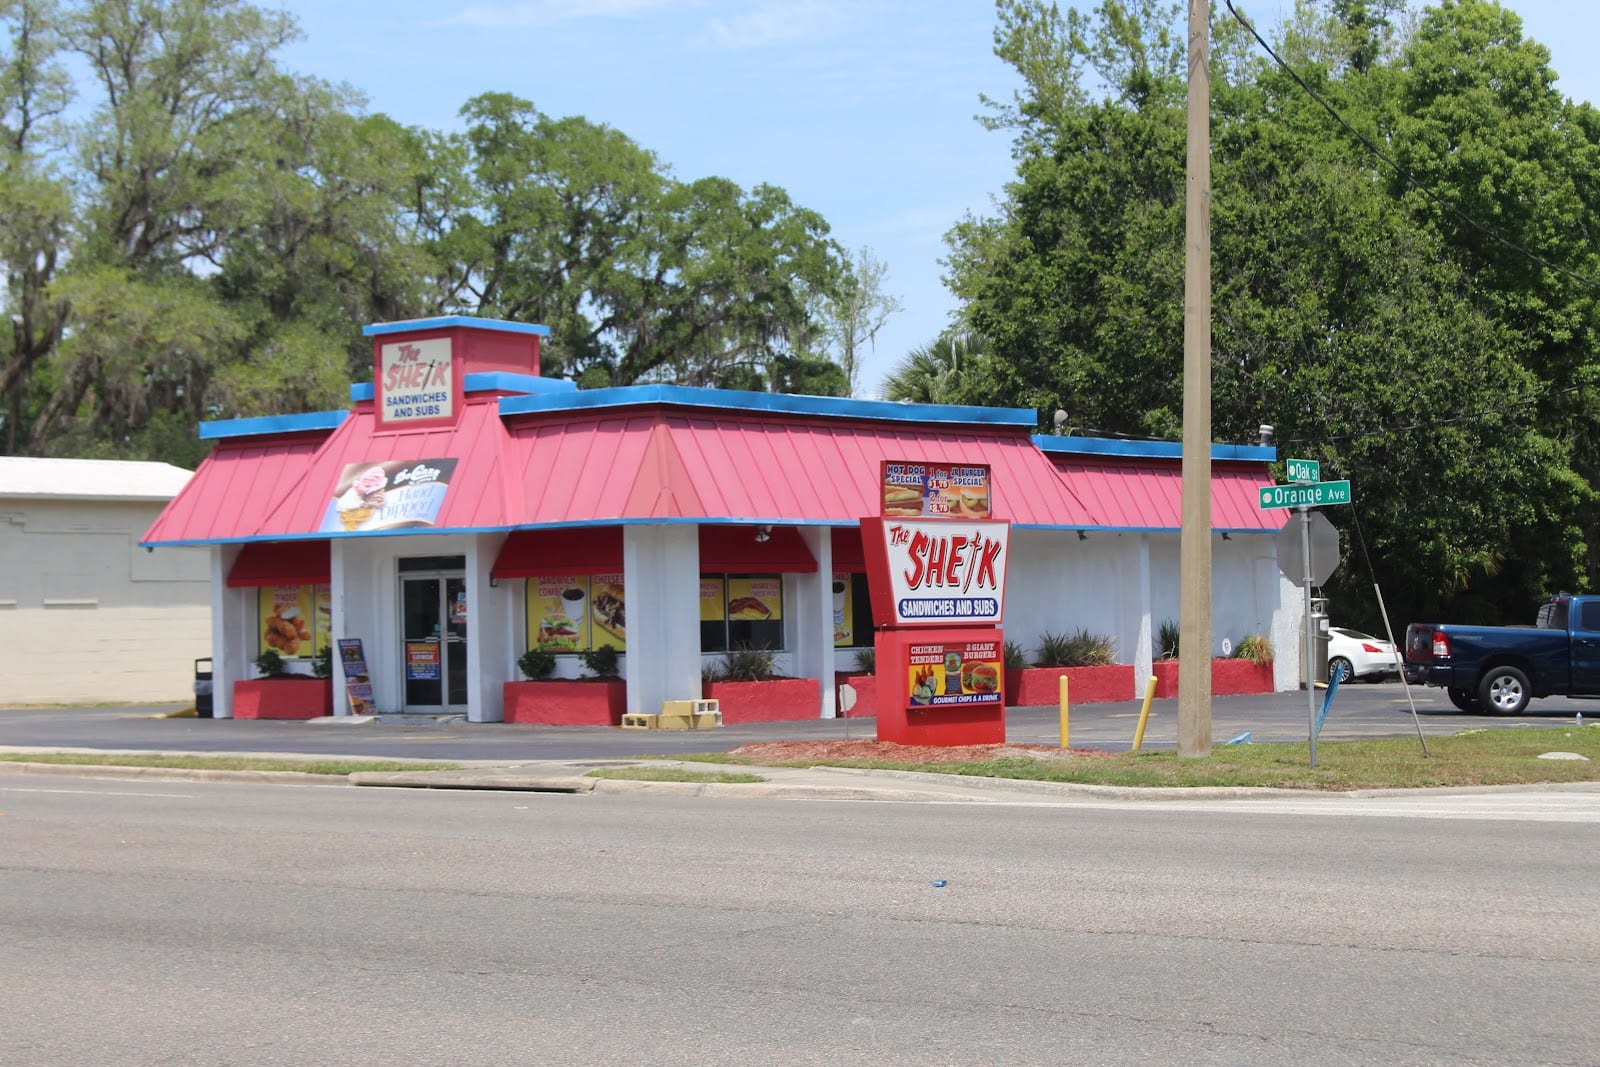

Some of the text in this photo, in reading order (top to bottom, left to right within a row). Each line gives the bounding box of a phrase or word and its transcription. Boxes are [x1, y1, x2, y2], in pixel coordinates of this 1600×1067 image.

[384, 359, 450, 392] SHEIK
[386, 391, 447, 406] SANDWICHES
[394, 405, 440, 417] AND SUBS
[887, 465, 925, 475] HOT DOG
[929, 468, 935, 478] 1
[951, 468, 986, 477] JR BURGER
[1295, 463, 1310, 480] Oak
[890, 474, 922, 484] SPECIAL
[953, 477, 983, 487] SPECIAL
[929, 492, 948, 503] 2 for
[1274, 488, 1345, 504] Orange Ave
[890, 525, 909, 545] The
[904, 530, 1001, 594] SHEIK
[902, 600, 995, 616] SANDWICHES AND SUBS
[911, 646, 944, 654] CHICKEN
[972, 643, 995, 651] GIANT
[911, 656, 944, 664] TENDERS
[964, 651, 997, 659] BURGERS
[933, 696, 958, 704] GOURMET
[958, 695, 973, 703] CHIPS
